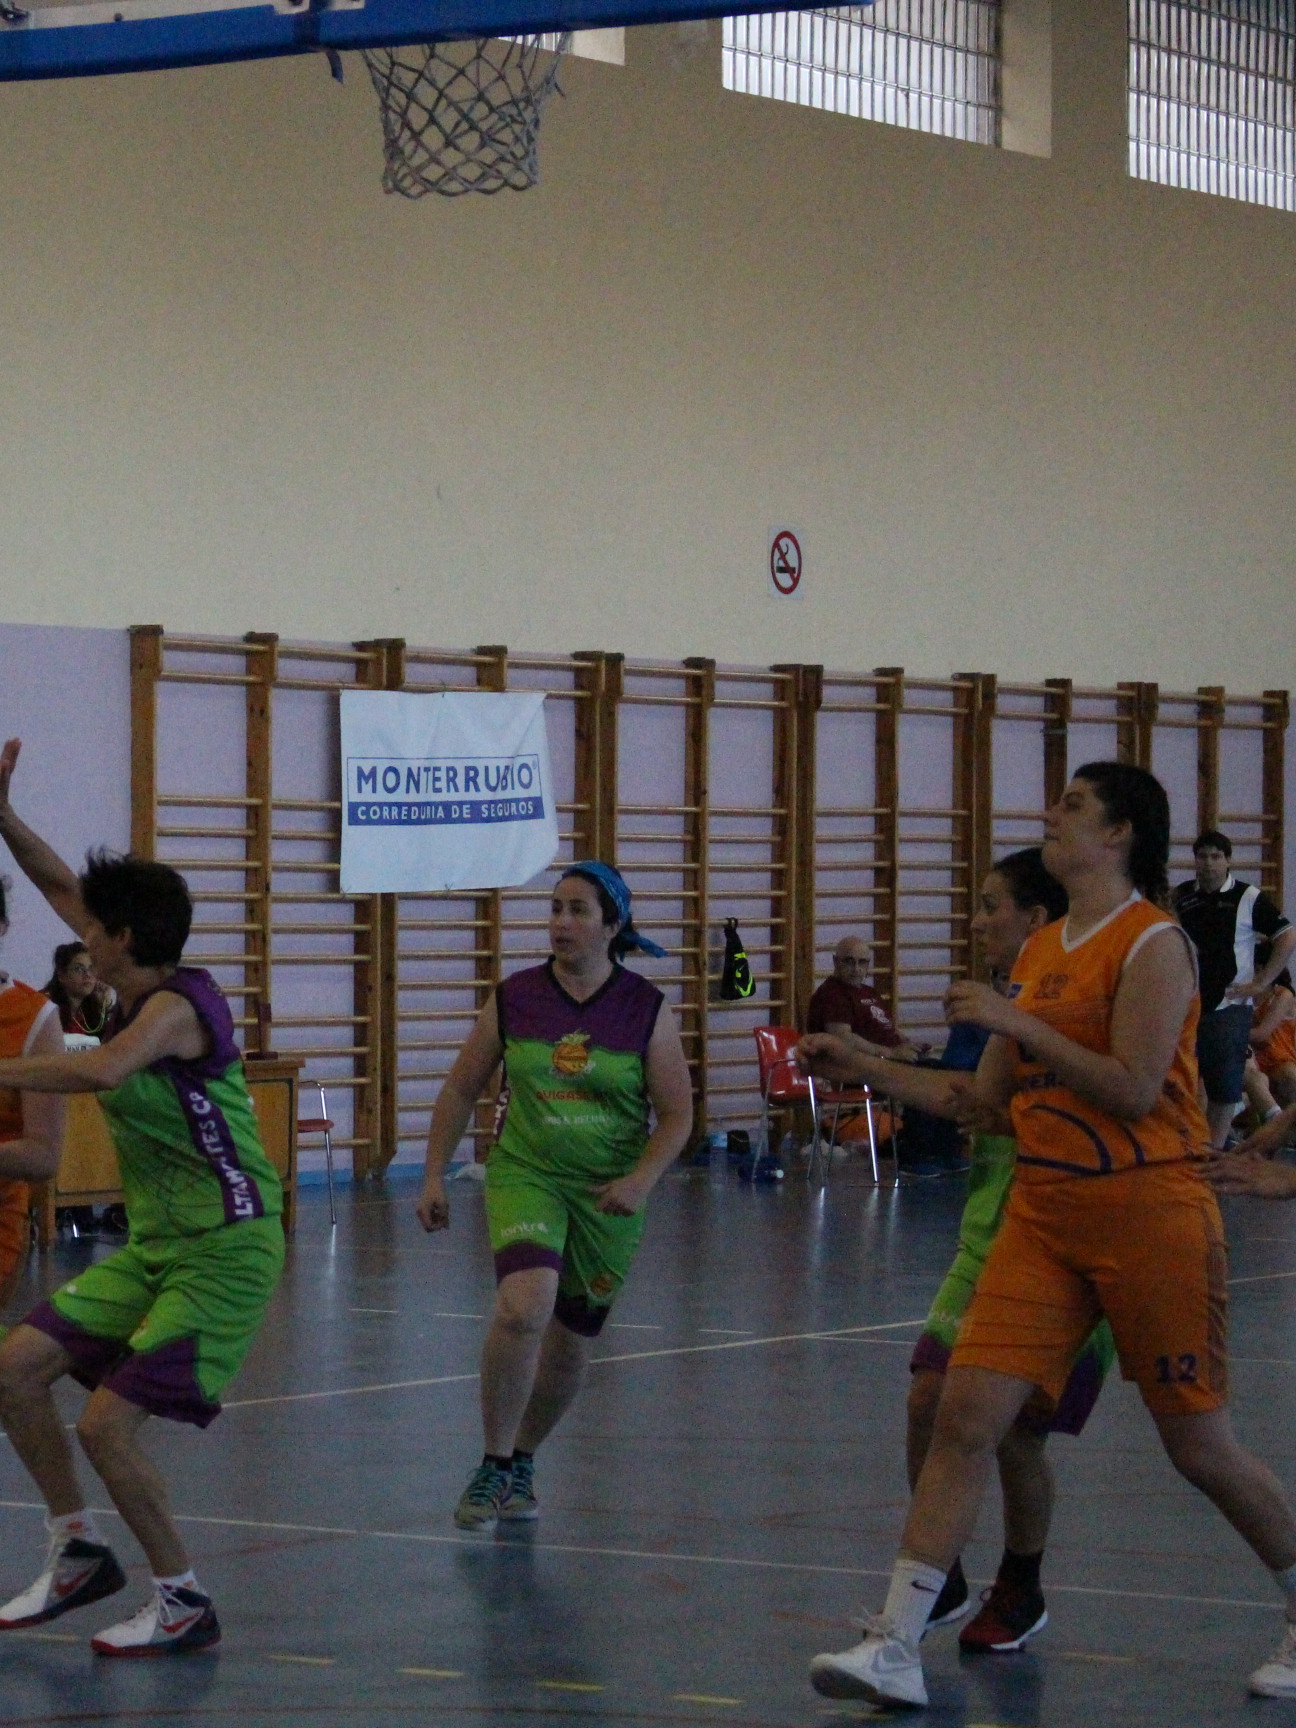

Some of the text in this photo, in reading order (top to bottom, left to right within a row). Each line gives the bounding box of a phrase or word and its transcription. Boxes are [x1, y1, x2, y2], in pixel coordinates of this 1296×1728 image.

[357, 763, 533, 794] MONTERRUBIO
[357, 801, 534, 820] CORREDURIA DE SEGUROS
[1156, 1354, 1198, 1383] 12
